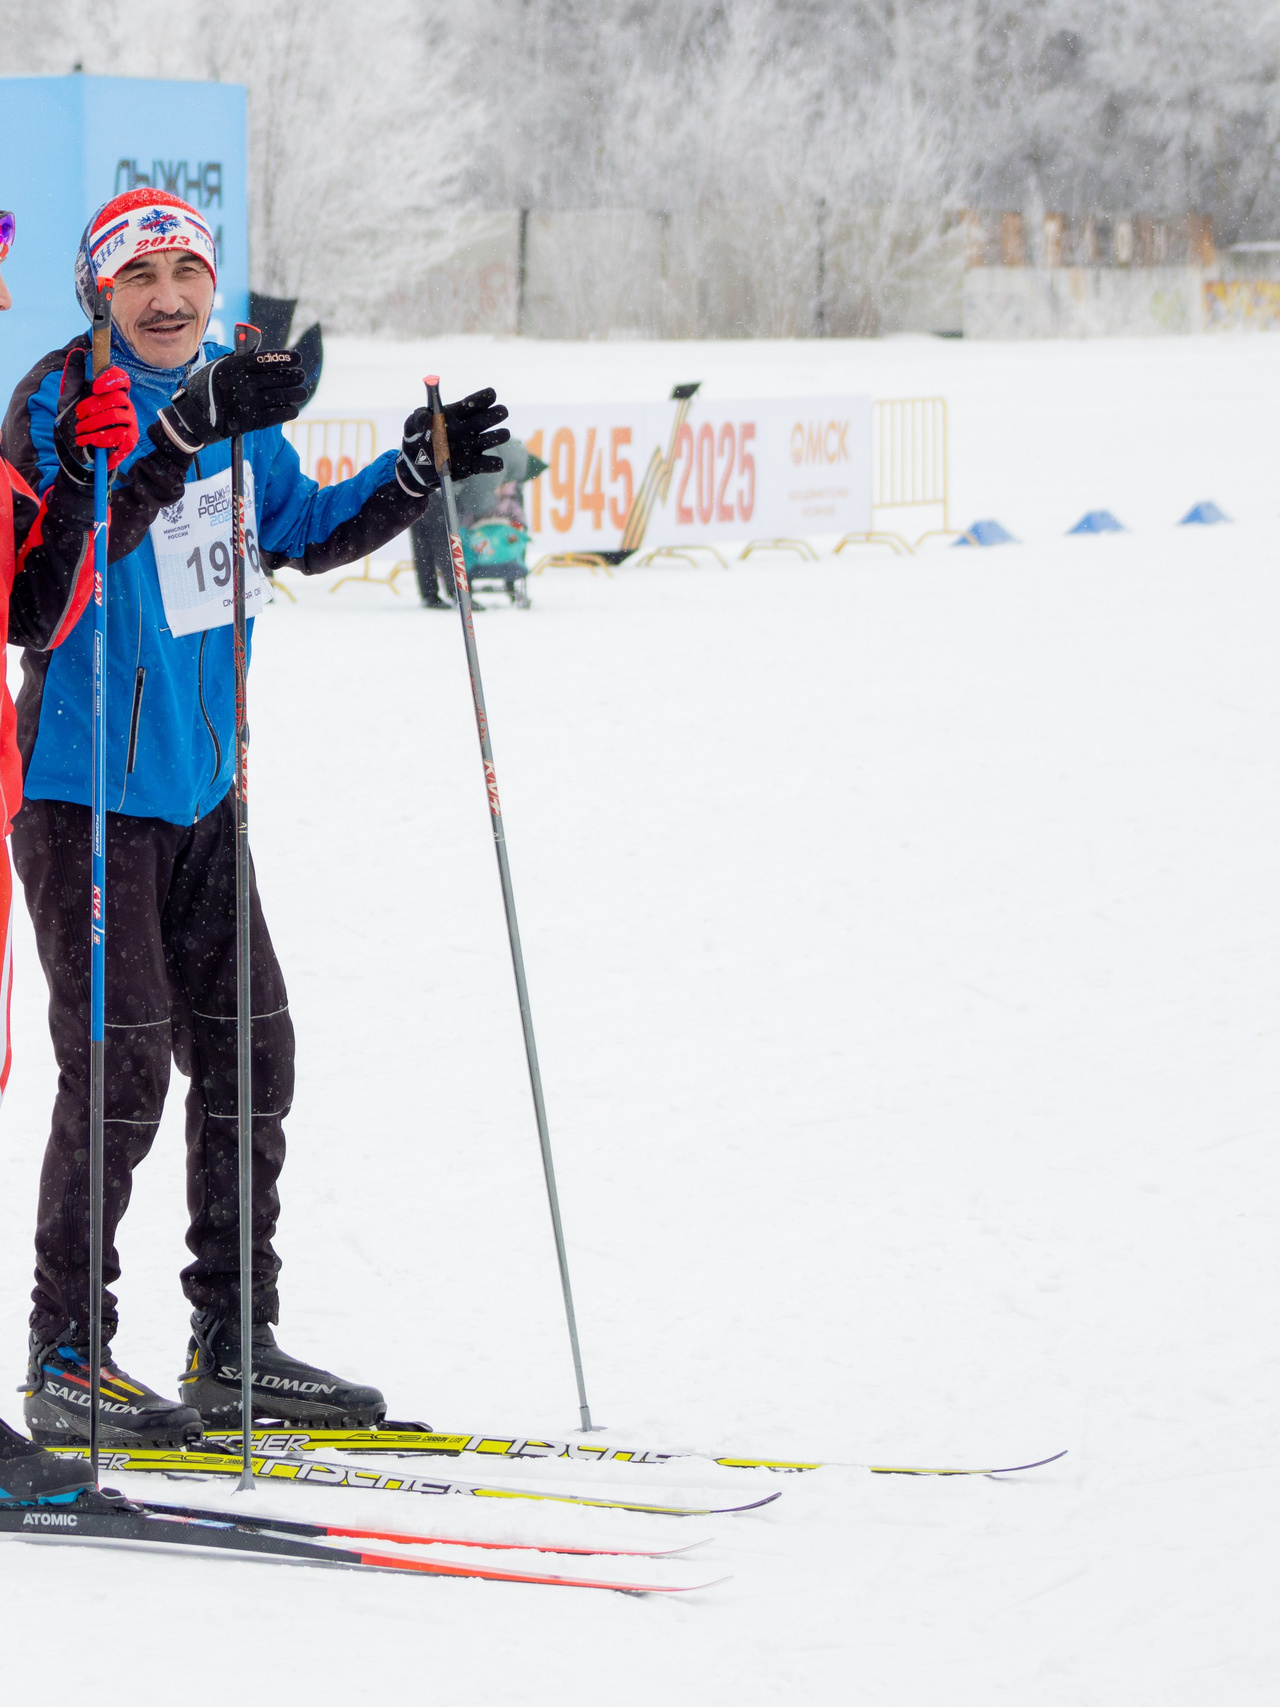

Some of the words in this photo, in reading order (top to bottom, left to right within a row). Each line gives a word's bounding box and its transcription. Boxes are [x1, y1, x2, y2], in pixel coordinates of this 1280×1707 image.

[113, 158, 223, 209] ЛЫЖНЯ
[133, 235, 191, 254] 2013
[256, 352, 292, 364] adidas
[525, 426, 634, 533] 1945
[675, 421, 757, 525] 2025
[198, 497, 233, 519] РОССИ
[186, 528, 260, 593] 196
[22, 1513, 78, 1527] ATOMIC
